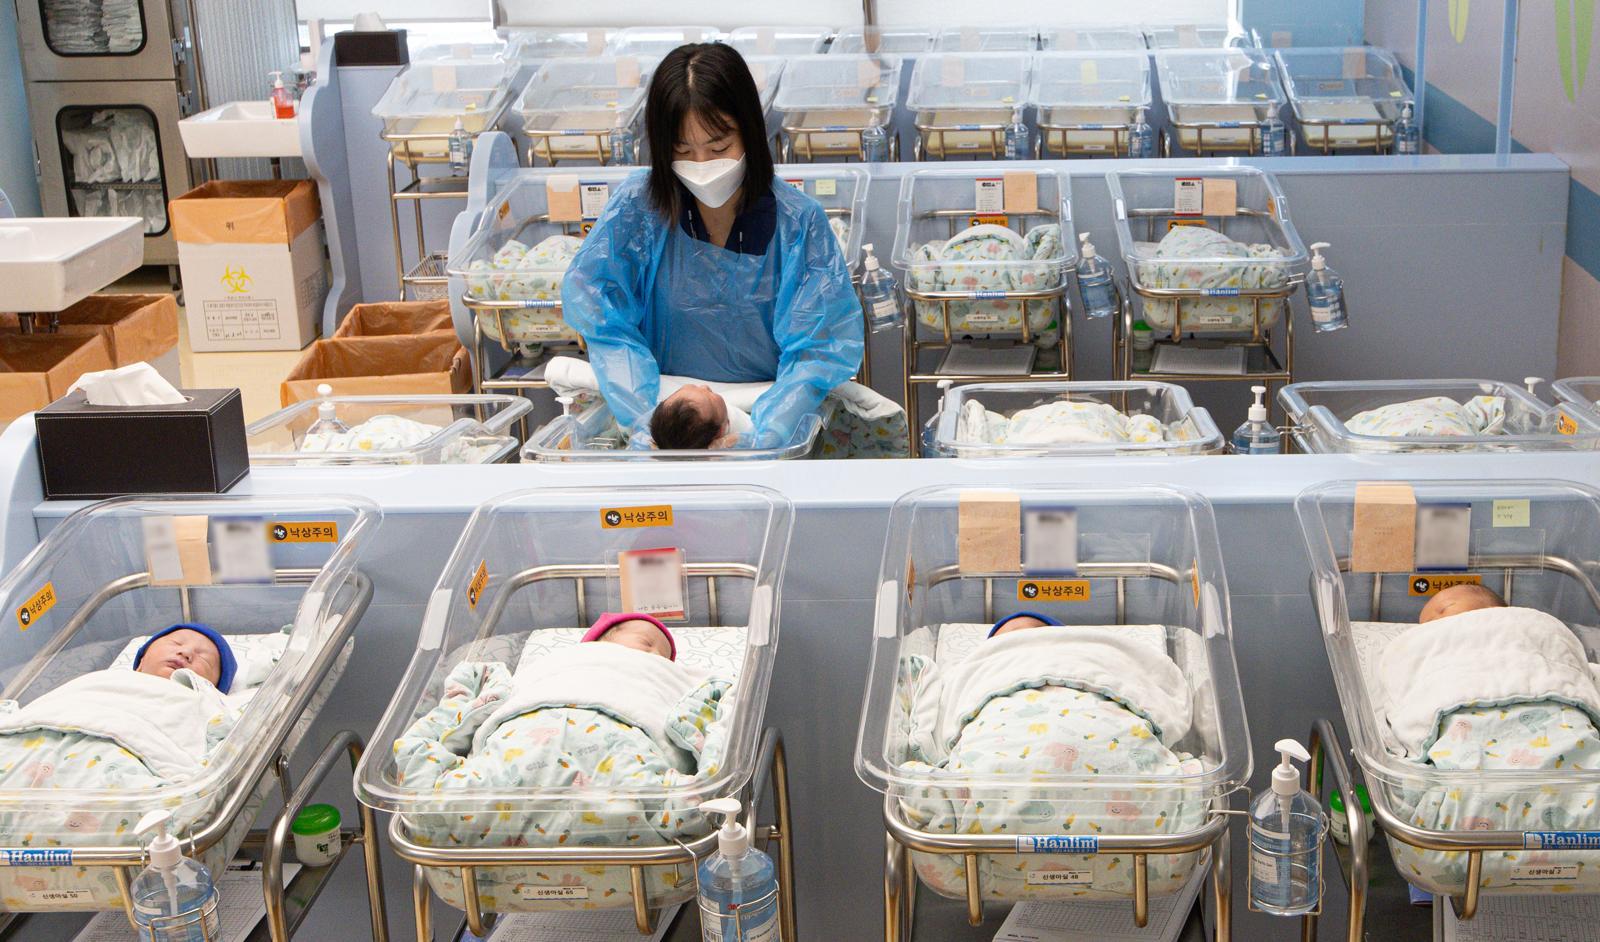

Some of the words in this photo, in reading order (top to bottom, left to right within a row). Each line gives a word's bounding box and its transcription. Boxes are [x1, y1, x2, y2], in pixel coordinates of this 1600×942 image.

[624, 511, 668, 523] 낙상주의
[290, 527, 333, 538] 낙상주의
[1041, 585, 1084, 596] 낙상주의
[29, 589, 53, 615] 낙상주의
[1035, 836, 1096, 849] Hanlim
[1542, 833, 1600, 846] Hanlim
[10, 850, 70, 863] Hanlim
